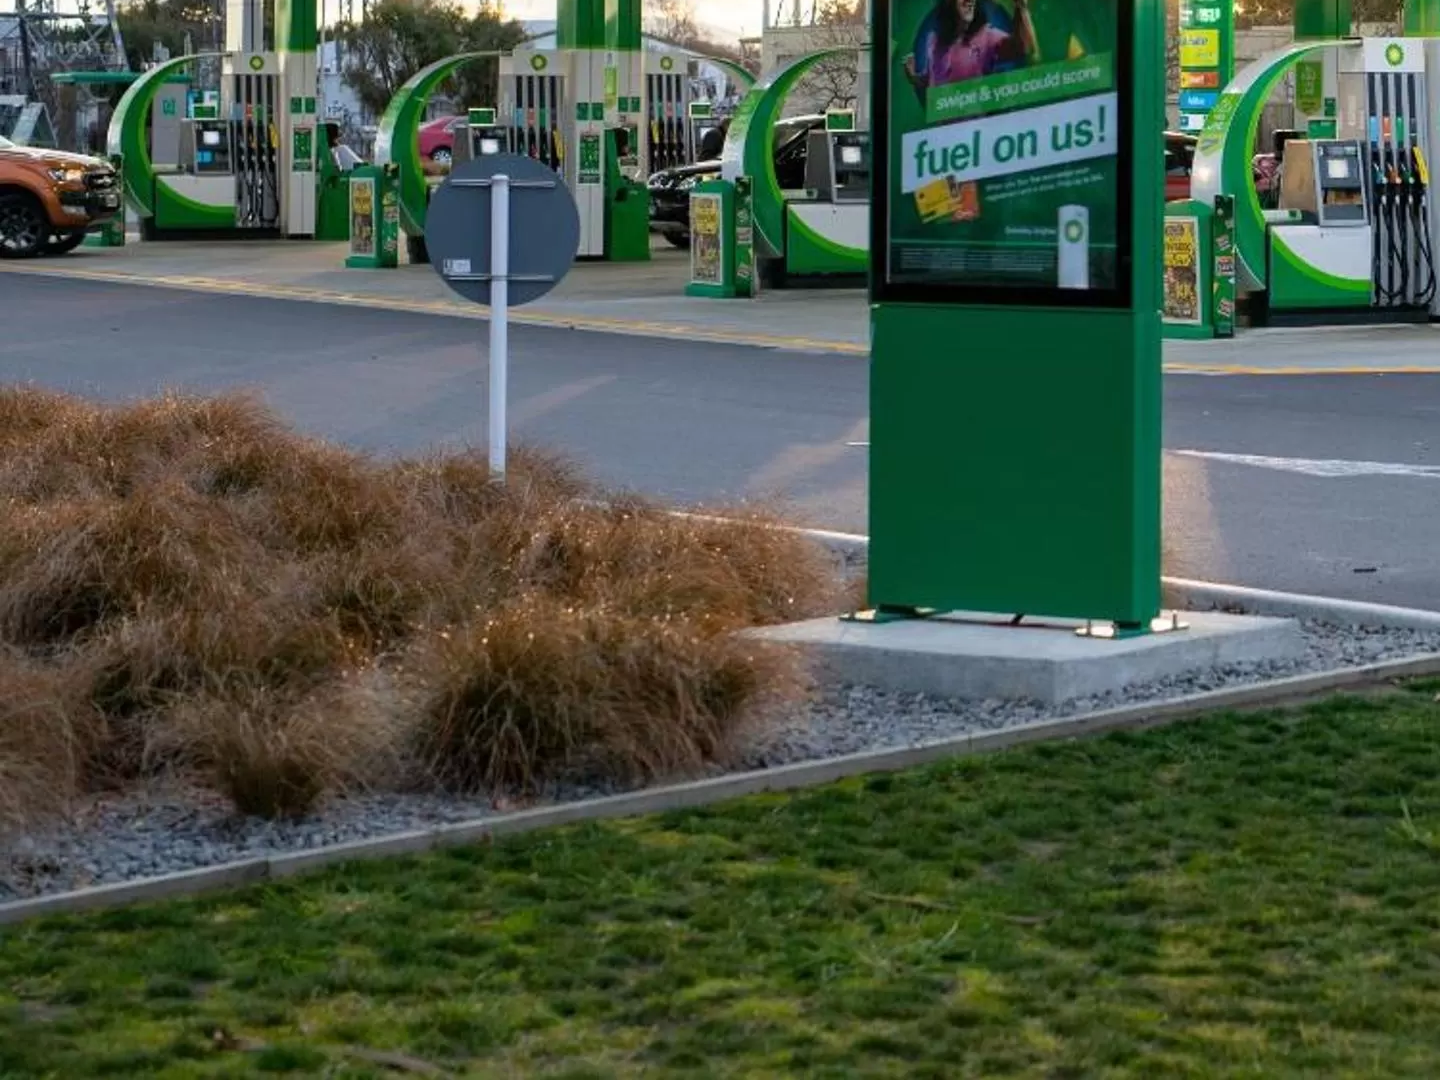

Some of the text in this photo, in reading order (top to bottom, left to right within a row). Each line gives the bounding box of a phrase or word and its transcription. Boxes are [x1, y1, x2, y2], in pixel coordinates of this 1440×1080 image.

[936, 91, 976, 111] swipe
[979, 87, 991, 102] &
[993, 82, 1019, 102] you
[1021, 73, 1060, 93] could
[914, 105, 1105, 178] fuel on us!
